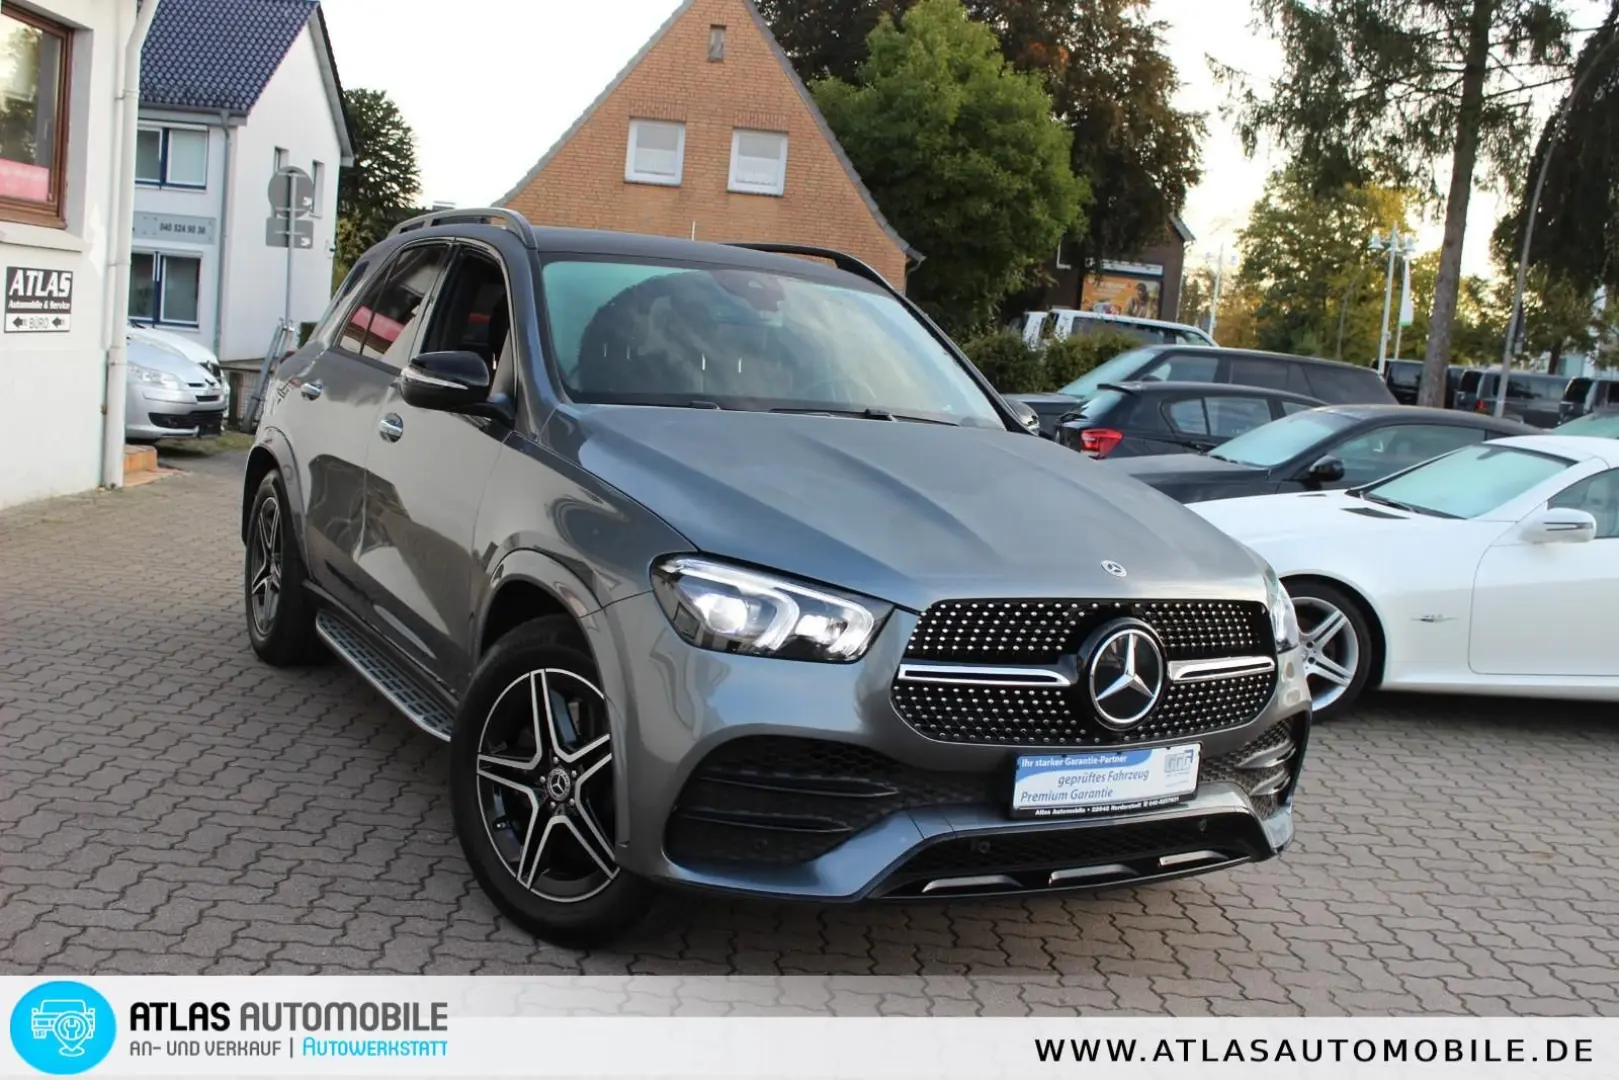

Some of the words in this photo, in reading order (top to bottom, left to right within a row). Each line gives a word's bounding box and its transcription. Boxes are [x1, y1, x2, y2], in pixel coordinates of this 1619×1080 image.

[8, 269, 72, 297] ATLAS
[49, 301, 70, 309] Service
[29, 316, 49, 329] BÜRO
[1021, 758, 1034, 768] Ihr
[1035, 757, 1064, 767] starker
[1065, 755, 1127, 765] Garantie-Partner
[1058, 771, 1106, 787] geprüftes
[1107, 769, 1149, 782] Fahrzeug
[1020, 790, 1068, 803] Premium
[1070, 787, 1113, 800] Garantie
